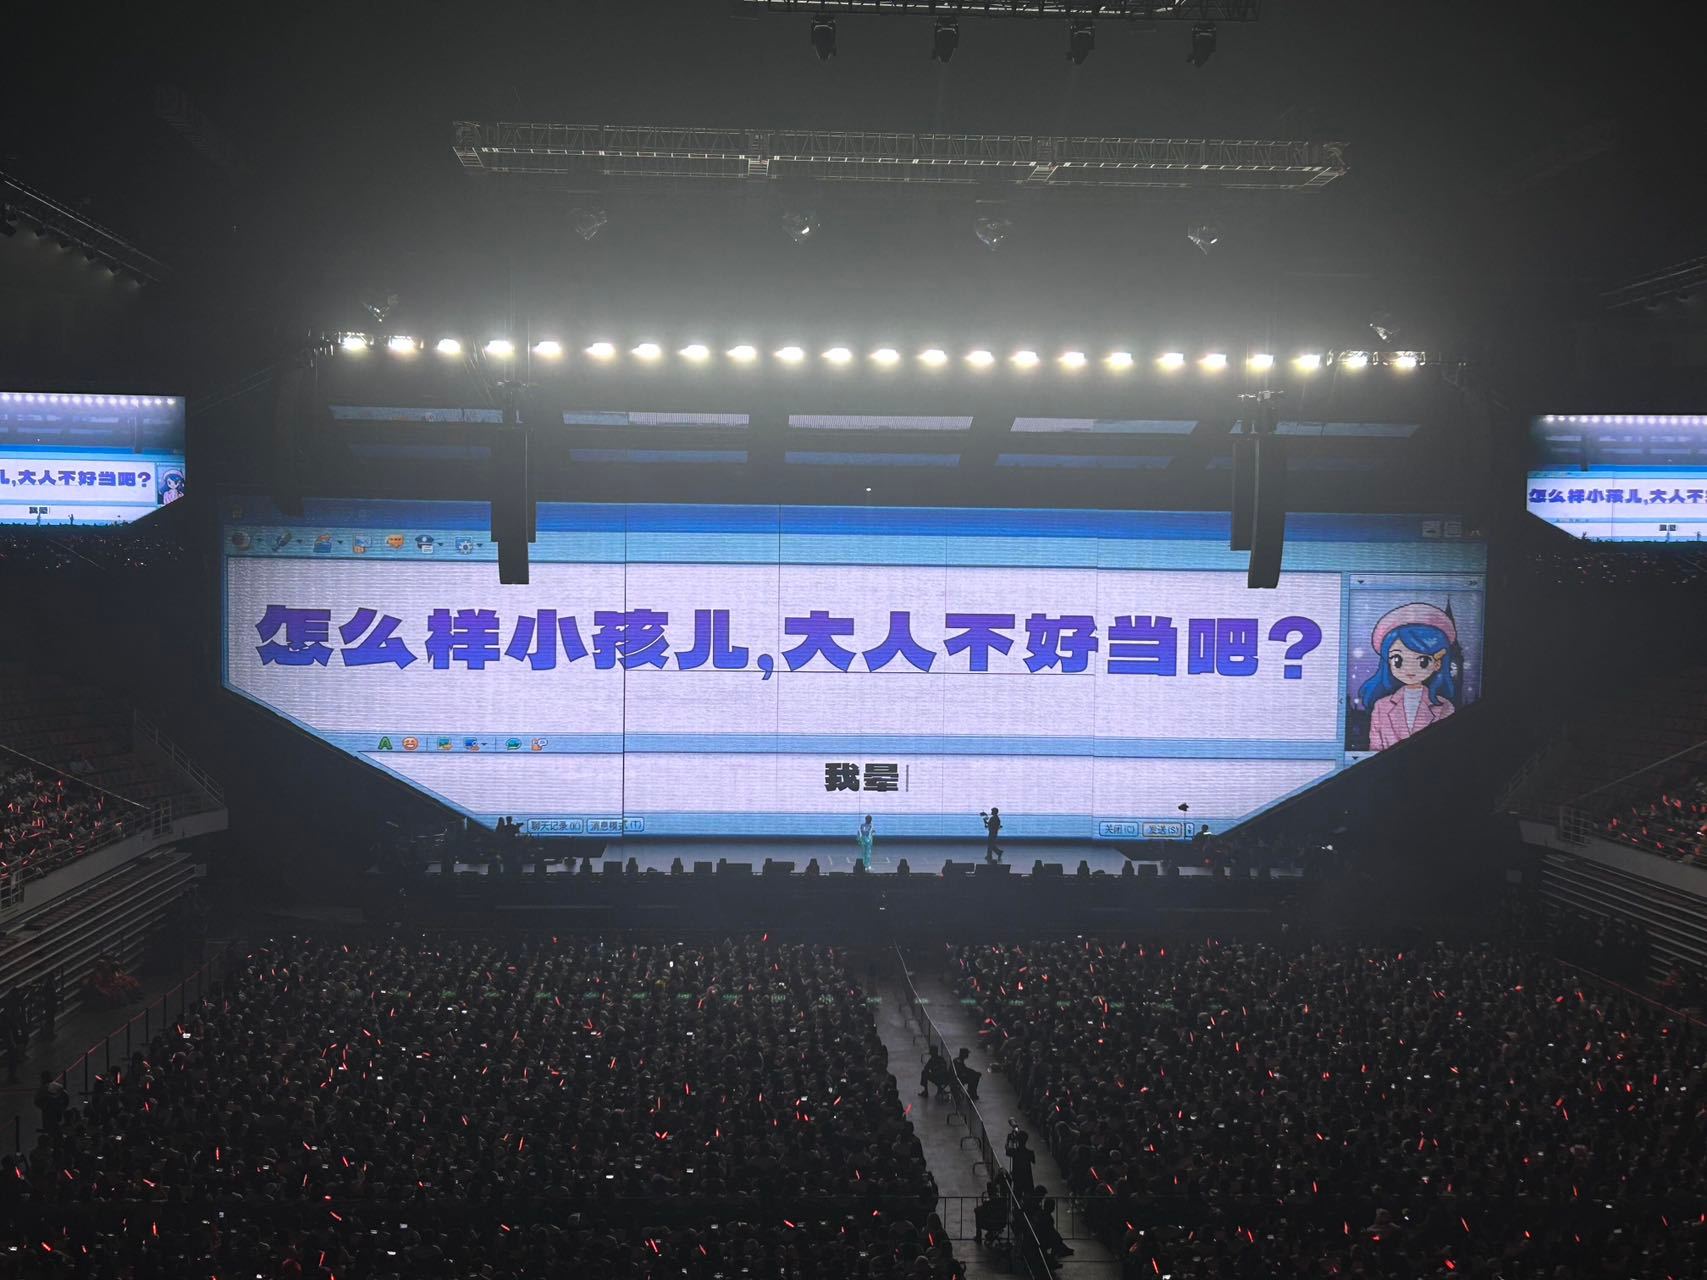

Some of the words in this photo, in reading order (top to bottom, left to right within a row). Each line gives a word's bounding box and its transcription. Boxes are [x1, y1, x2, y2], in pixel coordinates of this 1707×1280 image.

[1529, 489, 1707, 505] 怎么样小孩儿,大人不
[255, 605, 1322, 681] 怎么样小孩儿,大人不好当吧?
[824, 763, 899, 792] 我晕
